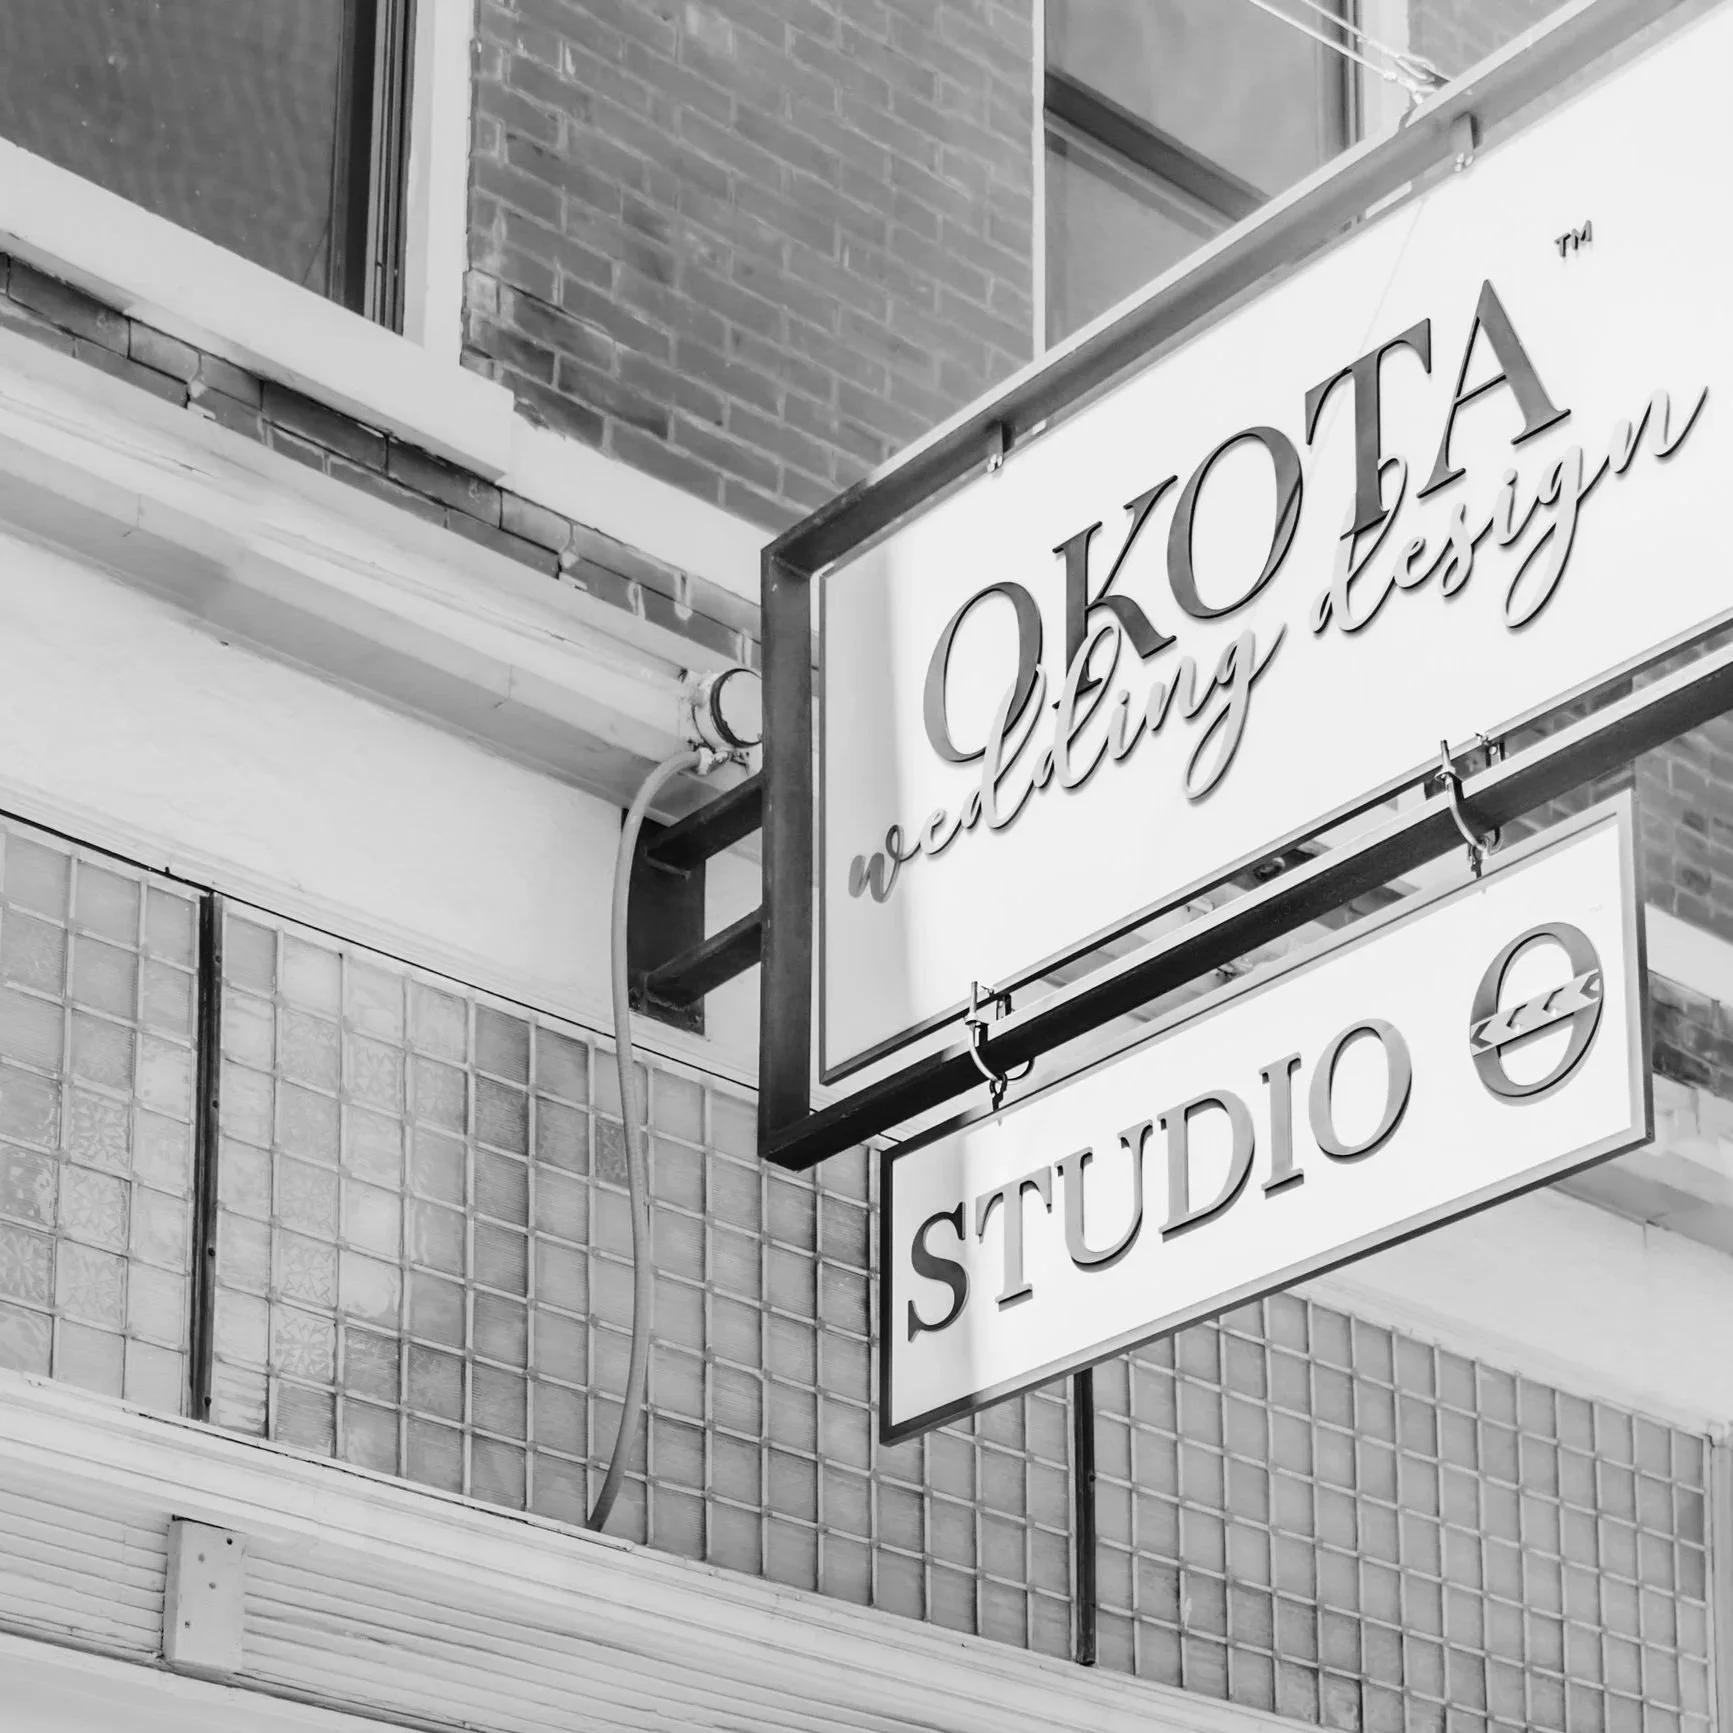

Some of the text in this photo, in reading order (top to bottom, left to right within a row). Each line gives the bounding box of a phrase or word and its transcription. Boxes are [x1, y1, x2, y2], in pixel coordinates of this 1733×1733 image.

[848, 385, 1710, 903] wedding design
[923, 279, 1571, 764] OKOTA
[908, 1017, 1413, 1342] STUDIO
